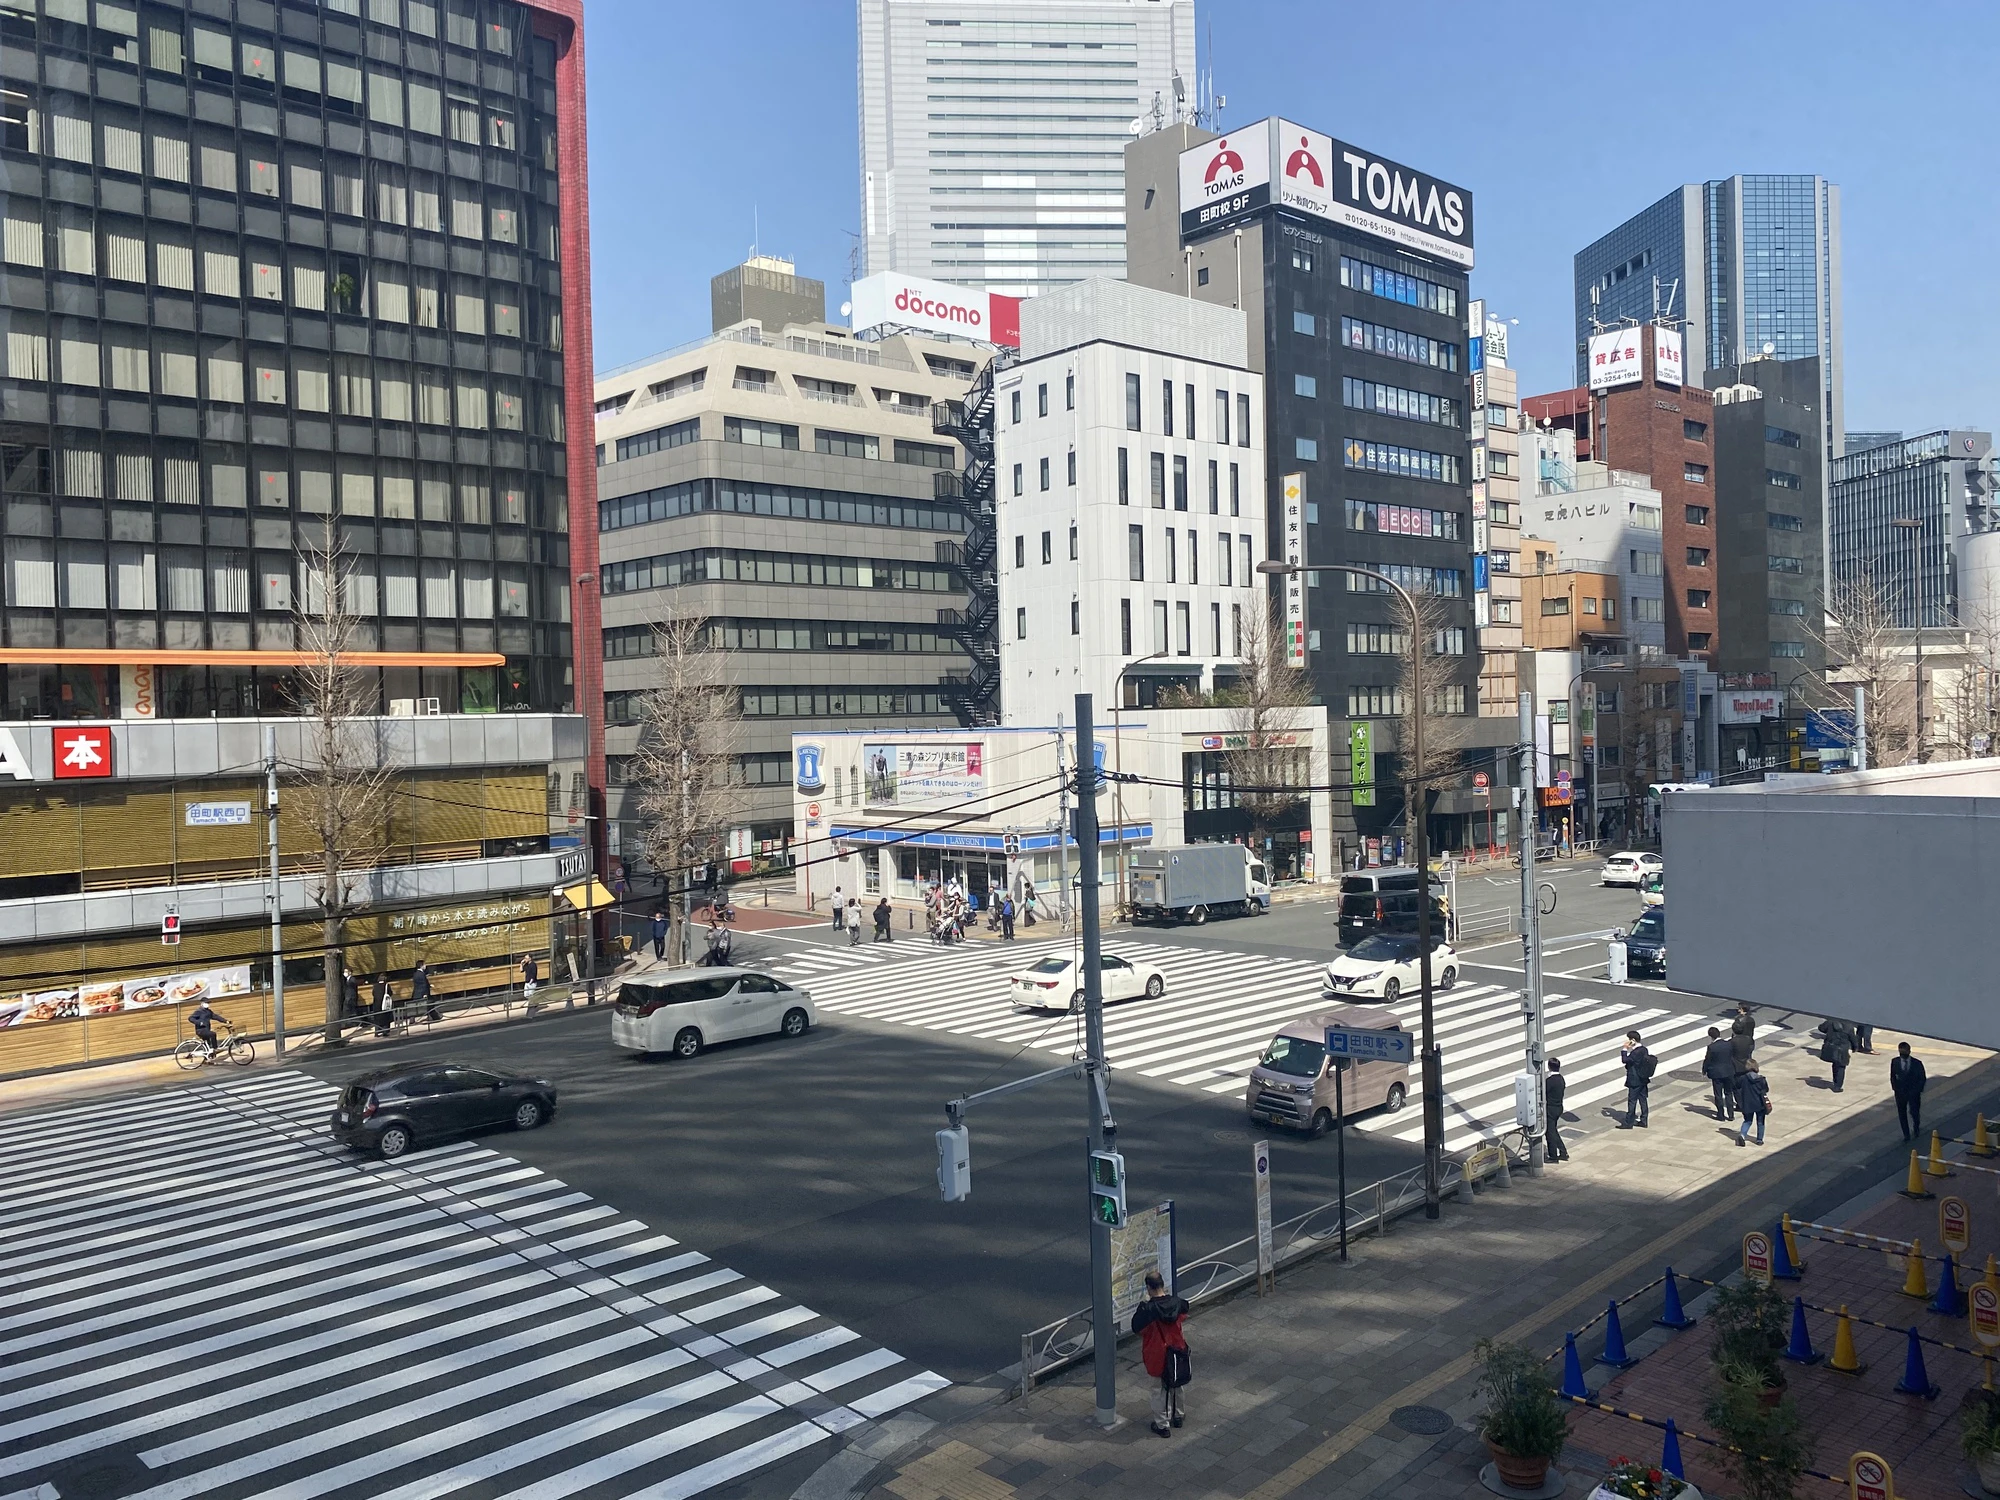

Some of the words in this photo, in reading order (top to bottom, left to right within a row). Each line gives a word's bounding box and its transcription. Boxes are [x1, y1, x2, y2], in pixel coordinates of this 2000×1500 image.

[1204, 174, 1244, 197] TOMAS
[1343, 151, 1464, 237] TOMAS
[1200, 202, 1231, 224] 田町校
[1232, 193, 1250, 213] 9F
[1283, 225, 1323, 244] セブン三田ビル
[909, 288, 922, 297] NTT
[894, 287, 981, 326] docomo
[1377, 334, 1428, 360] TOMAS
[1595, 347, 1636, 366] 貸広告
[1592, 370, 1640, 385] 03-3254-1941
[1366, 448, 1440, 473] 住友不動産販売
[1391, 512, 1421, 530] ECC
[1288, 505, 1300, 614] 住友不動産販売
[62, 735, 103, 770] 本
[899, 751, 965, 763] 三鷹の森ジブリ美術館
[190, 807, 246, 818] 田町駅西口
[949, 836, 980, 846] LAWSON
[392, 902, 531, 930] 朝7時から本を読みながら
[1349, 1046, 1376, 1056] Tamachi
[1350, 1034, 1388, 1050] 田町駅
